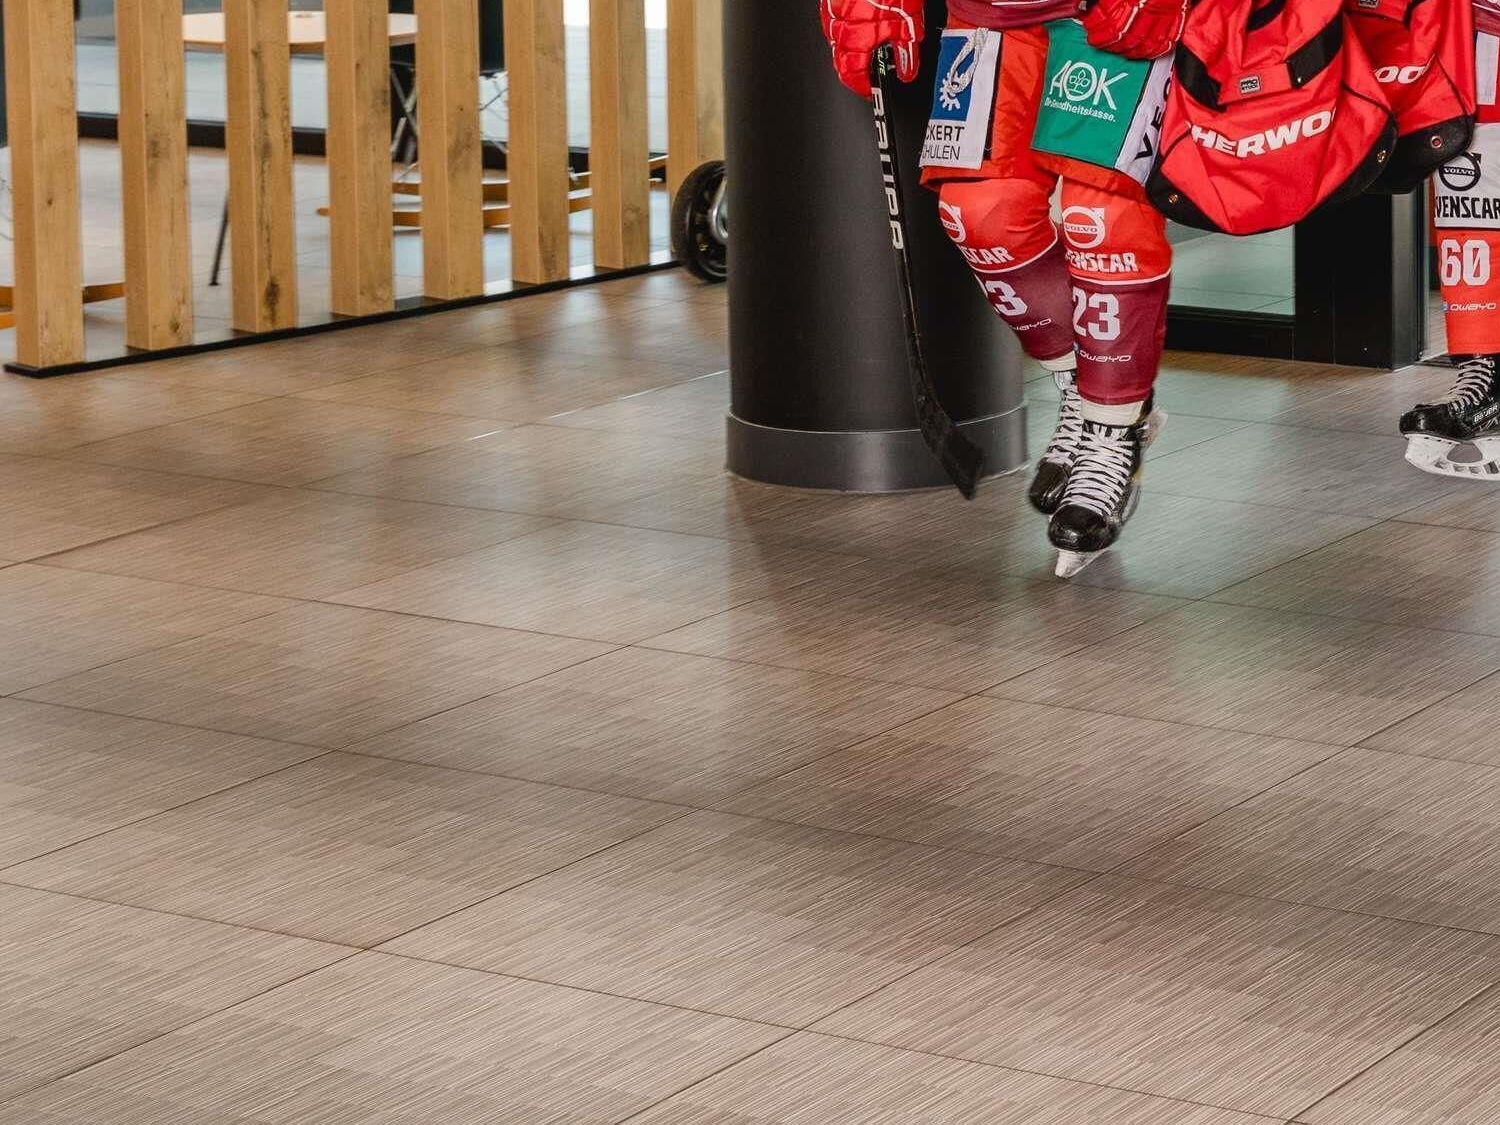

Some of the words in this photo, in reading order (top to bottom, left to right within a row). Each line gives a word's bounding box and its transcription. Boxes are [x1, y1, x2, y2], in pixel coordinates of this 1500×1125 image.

[1049, 59, 1129, 111] AOK
[1443, 167, 1476, 176] VOLVO
[1440, 239, 1490, 286] 60
[1072, 285, 1121, 342] 23
[1450, 302, 1497, 311] owayo
[1078, 349, 1132, 363] owayo
